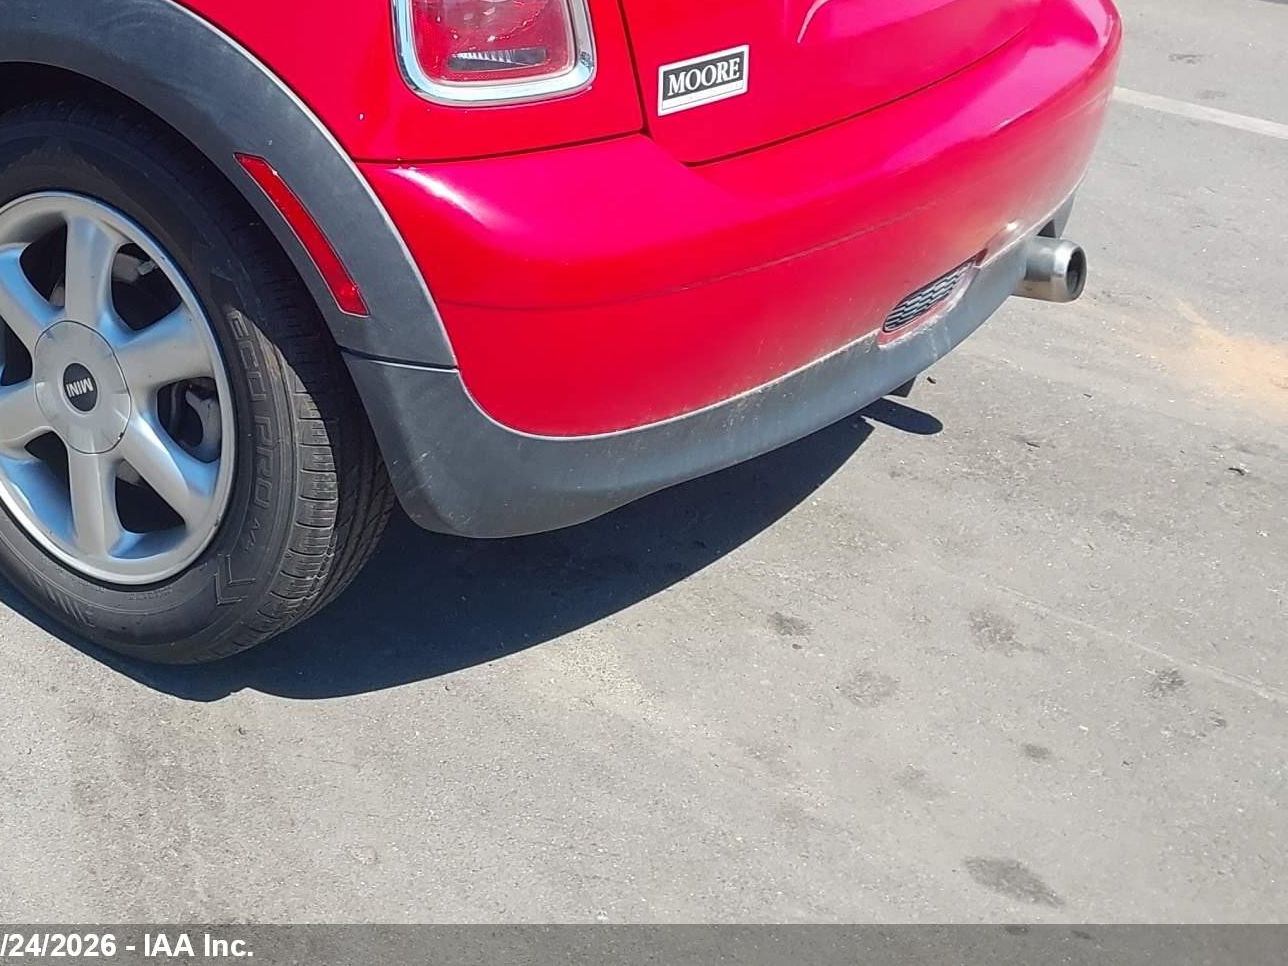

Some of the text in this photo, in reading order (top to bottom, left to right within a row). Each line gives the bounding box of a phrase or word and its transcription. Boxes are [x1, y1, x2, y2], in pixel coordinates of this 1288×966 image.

[667, 57, 740, 96] MOORE
[66, 377, 94, 398] MINI
[229, 311, 266, 401] ECO
[254, 414, 273, 508] PRO
